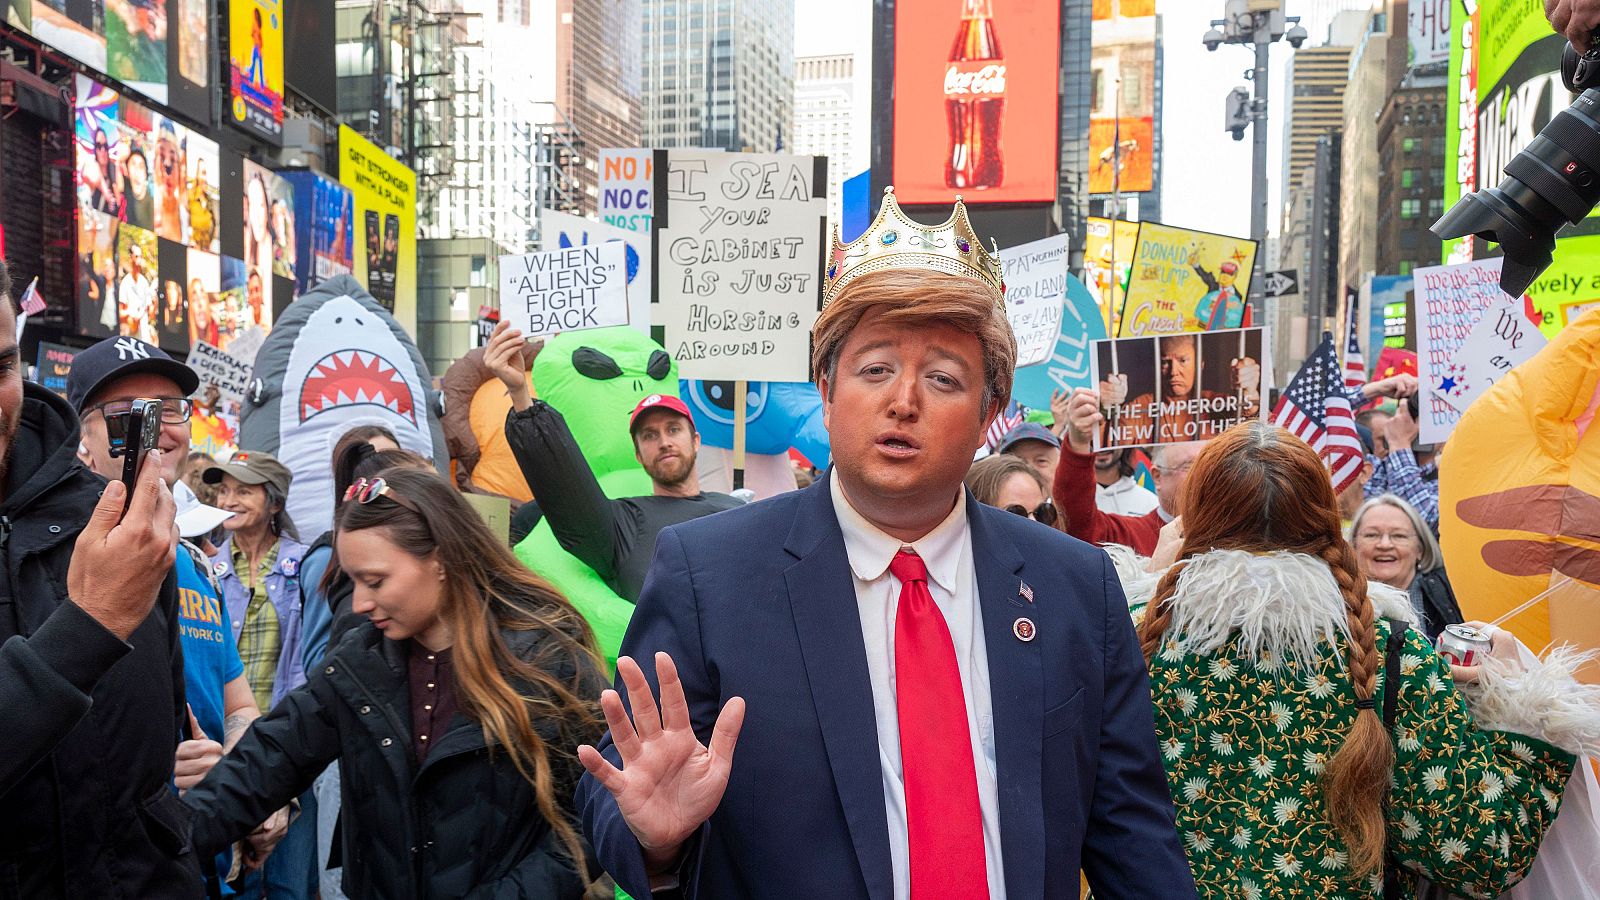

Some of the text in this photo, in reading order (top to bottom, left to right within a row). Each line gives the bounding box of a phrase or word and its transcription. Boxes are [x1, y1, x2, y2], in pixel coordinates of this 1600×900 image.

[943, 65, 1007, 95] Coca-Cola
[604, 156, 637, 181] NO
[668, 160, 708, 201] I
[721, 160, 809, 201] SEA
[604, 188, 632, 209] NO
[699, 206, 771, 234] YOUR
[524, 246, 600, 273] WHEN
[1141, 239, 1188, 266] DONALD
[509, 264, 616, 295] “ALIENS”
[730, 269, 811, 295] JUST
[1425, 272, 1449, 290] We
[526, 286, 602, 313] FIGHT
[1006, 285, 1032, 303] GOOD
[1155, 300, 1177, 312] THE
[530, 307, 600, 333] BACK
[1129, 301, 1185, 337] Great
[1495, 307, 1523, 350] We
[113, 337, 150, 360] NY
[675, 341, 776, 361] AROUND
[1047, 297, 1090, 396] ALL!
[200, 359, 248, 384] DIES IN
[200, 372, 246, 396] SILENC
[1106, 402, 1143, 420] THE
[1109, 424, 1154, 442] NEW
[187, 625, 214, 642] YORK
